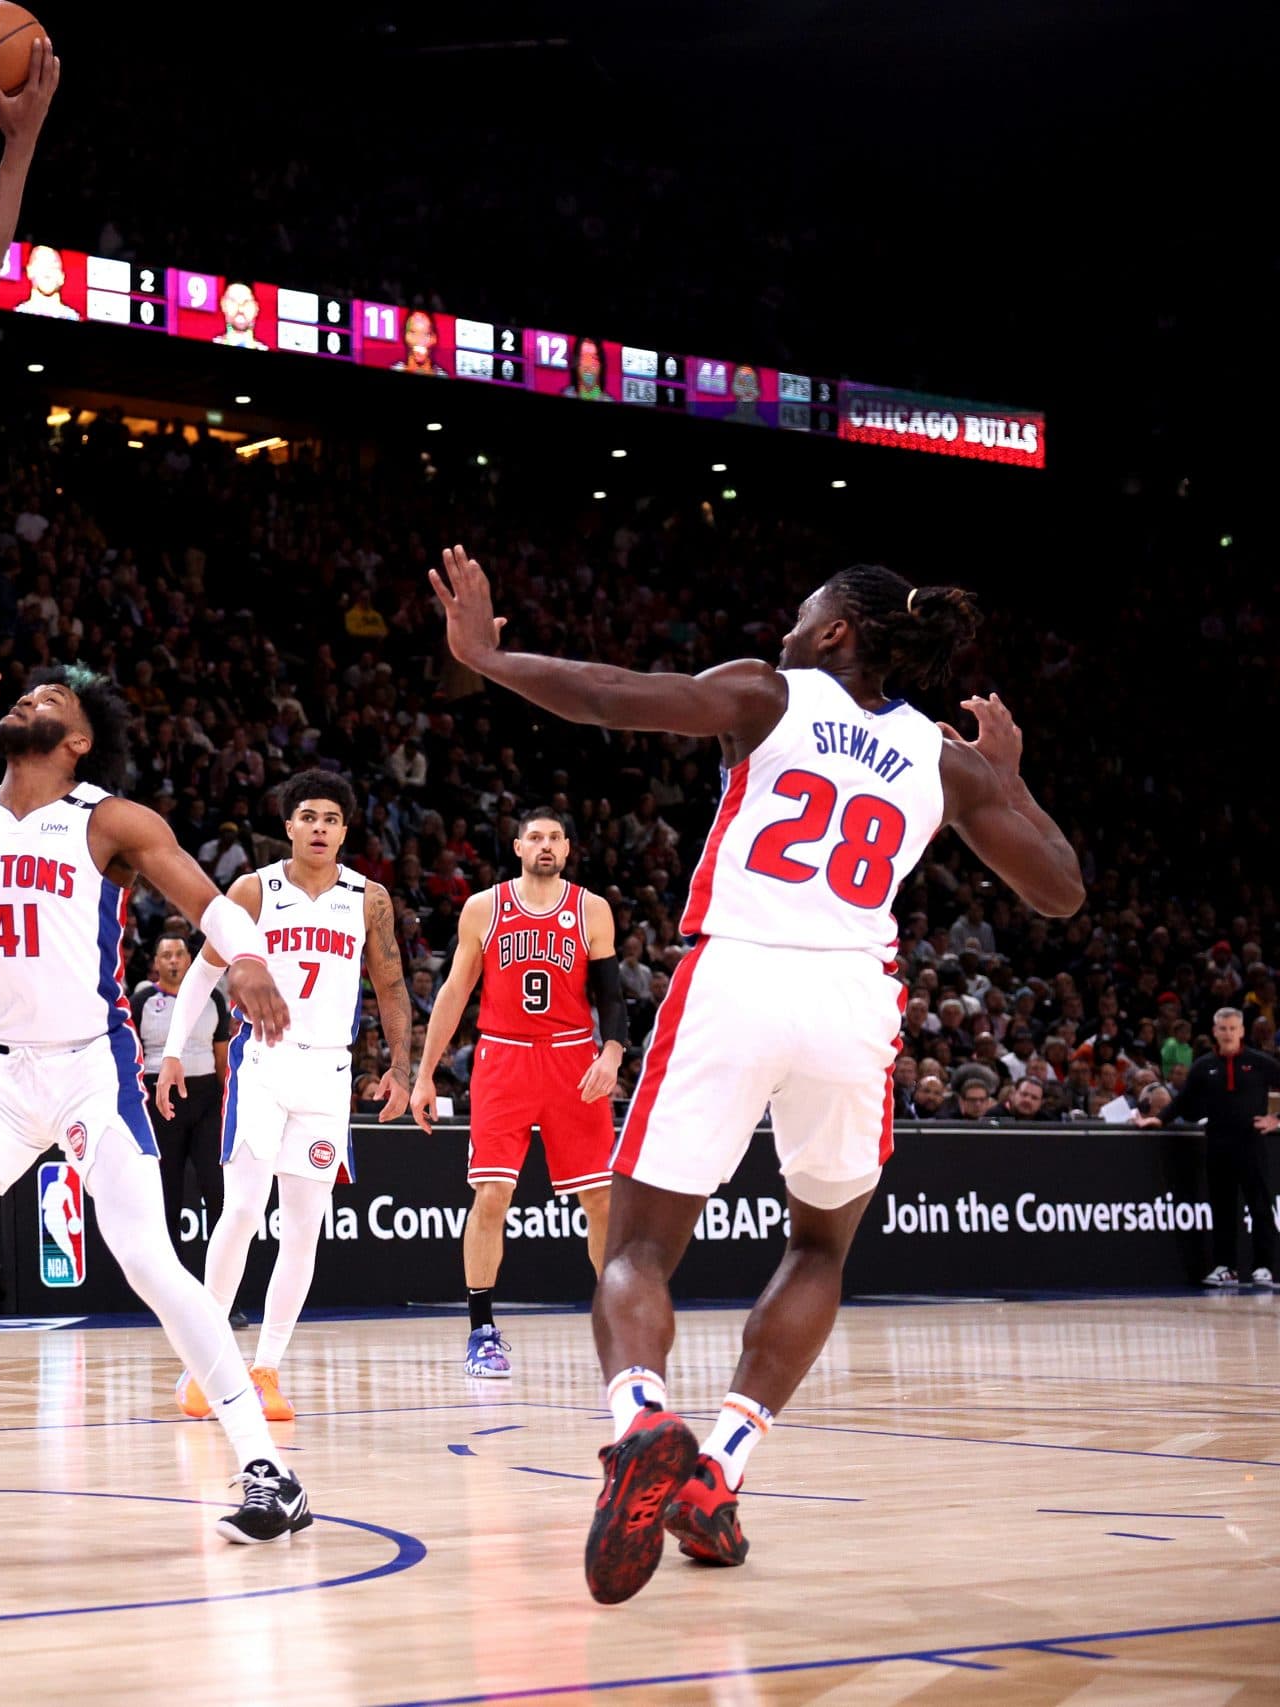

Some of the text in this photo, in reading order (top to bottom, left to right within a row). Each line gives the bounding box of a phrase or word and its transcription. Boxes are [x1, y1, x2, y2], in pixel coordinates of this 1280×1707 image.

[140, 269, 155, 292] 2
[187, 276, 207, 307] 9
[140, 301, 154, 324] 0
[327, 301, 340, 323] 8
[364, 306, 395, 340] 11
[327, 331, 340, 354] 0
[501, 329, 514, 351] 2
[536, 335, 568, 367] 12
[849, 399, 1037, 453] CHICAGO BULLS
[812, 721, 914, 784] STEWART
[40, 822, 69, 832] UWM
[745, 768, 906, 910] 28
[265, 926, 357, 960] PISTONS
[497, 929, 577, 973] BULLS
[298, 961, 320, 999] 7
[522, 969, 551, 1014] 9
[368, 1195, 588, 1240] Convsatio
[693, 1198, 791, 1240] BAP
[882, 1192, 950, 1234] Join
[956, 1191, 1009, 1233] the
[1016, 1191, 1214, 1232] Conversation
[47, 1258, 69, 1278] NBA
